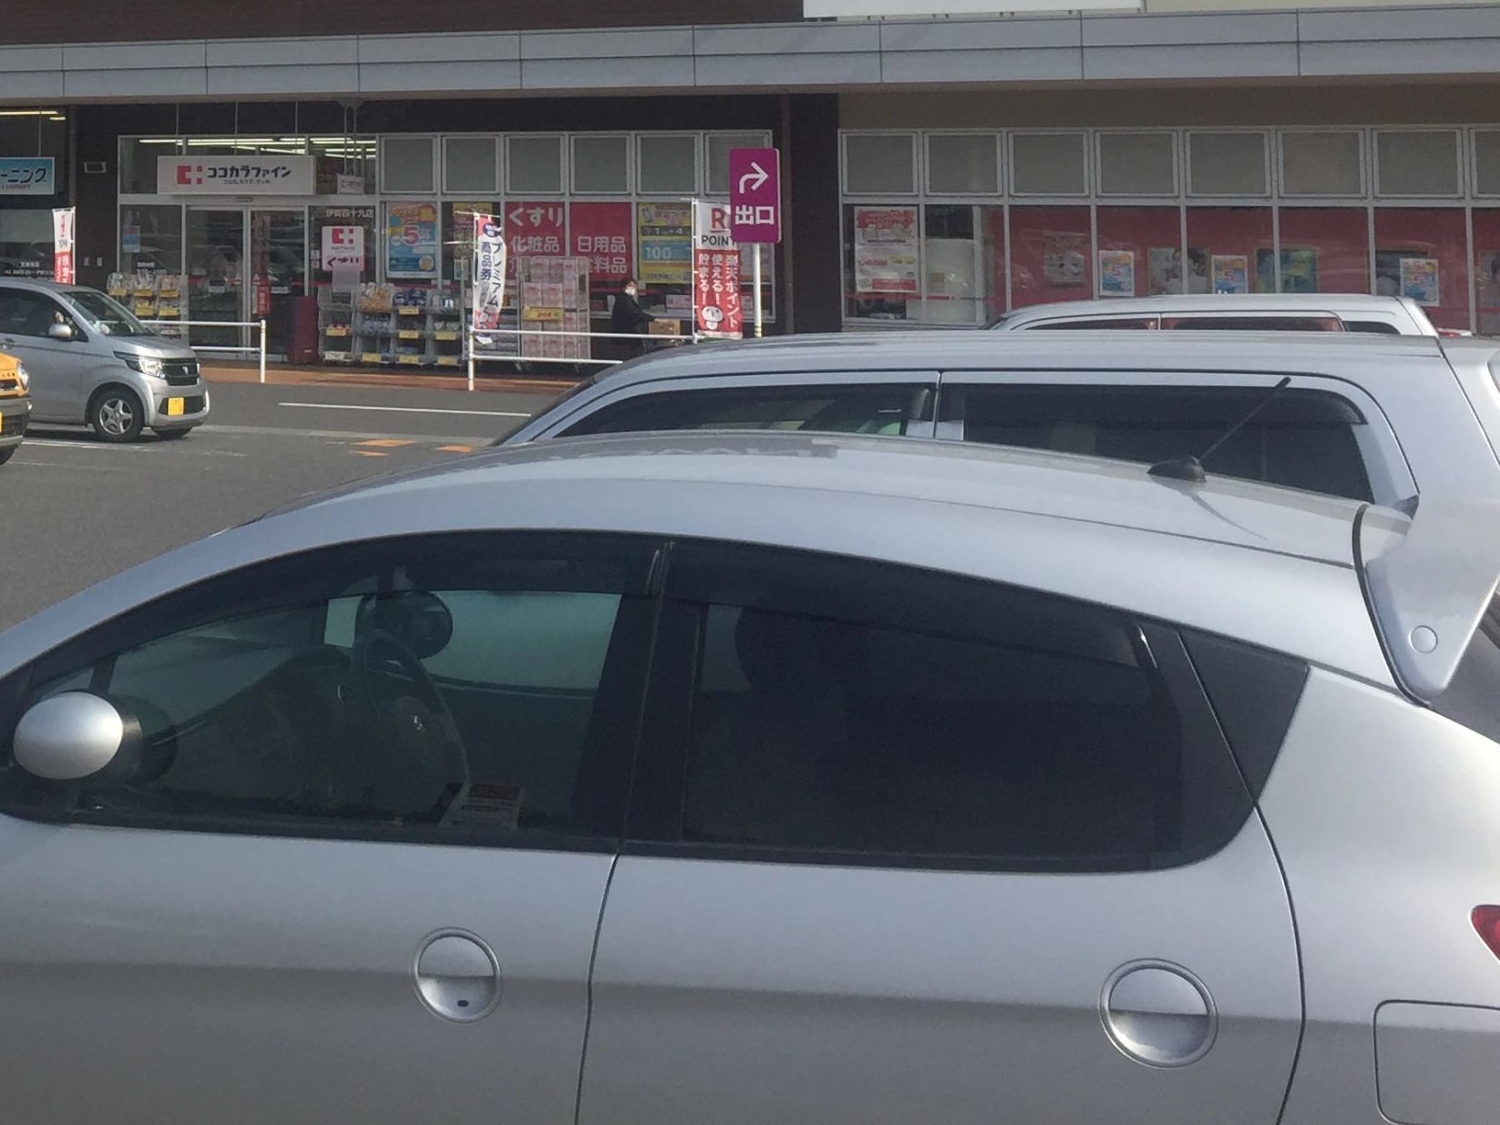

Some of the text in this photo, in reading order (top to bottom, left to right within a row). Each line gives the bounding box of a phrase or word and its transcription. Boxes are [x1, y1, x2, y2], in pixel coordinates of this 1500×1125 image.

[207, 165, 292, 179] ココカラファイン
[508, 206, 565, 227] くすり
[734, 204, 775, 226] 出口
[510, 235, 561, 253] 化粧品
[577, 235, 627, 253] 日用品
[588, 257, 628, 274] 料品
